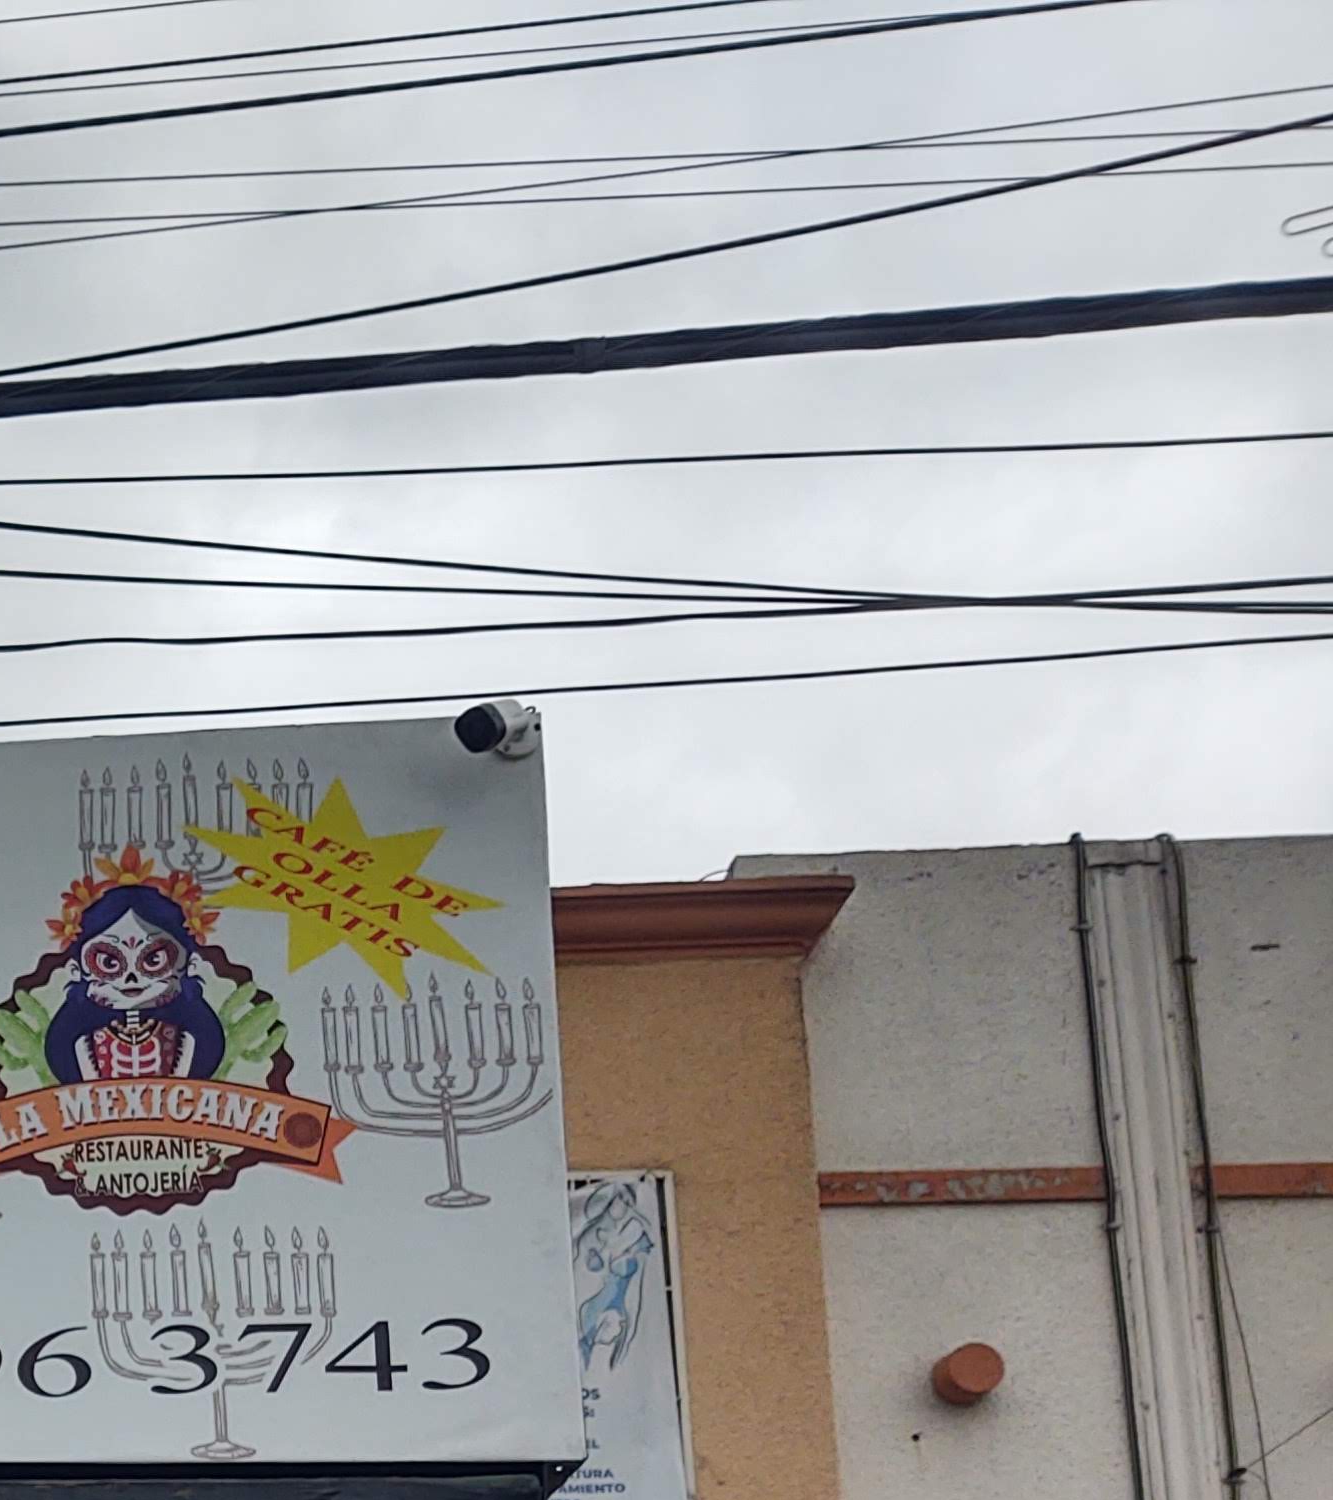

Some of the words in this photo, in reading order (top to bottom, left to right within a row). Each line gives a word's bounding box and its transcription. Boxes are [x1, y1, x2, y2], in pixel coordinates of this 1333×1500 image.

[247, 807, 374, 872] CAFÉ
[390, 875, 469, 917] DE
[272, 852, 402, 924] OLLA
[233, 865, 421, 958] GRATIS
[55, 1084, 285, 1142] MEXICANA
[74, 1138, 204, 1163] RESTAURANTE
[96, 1164, 203, 1196] ANTOJERÍA
[149, 1318, 491, 1394] 3743
